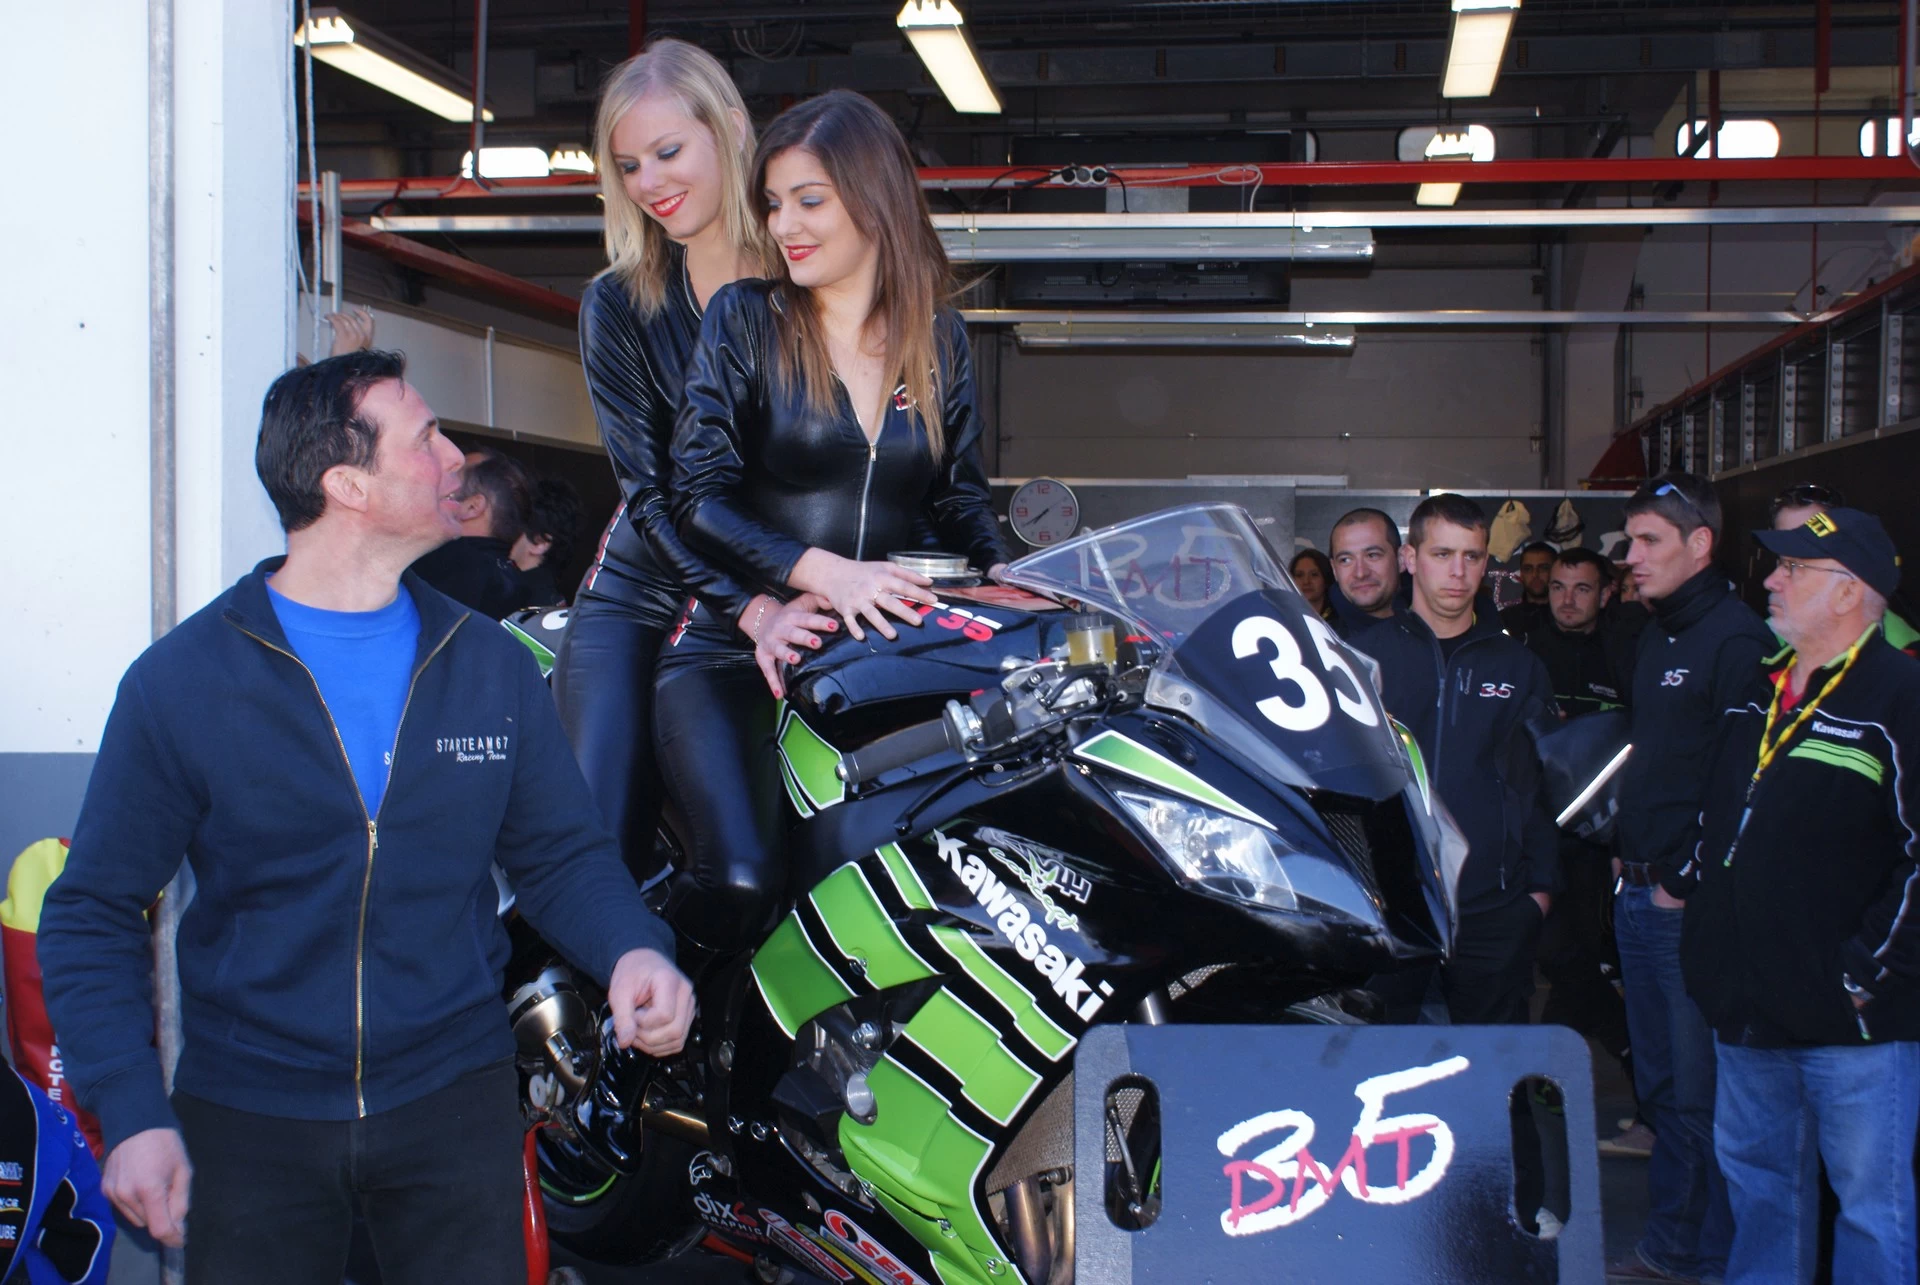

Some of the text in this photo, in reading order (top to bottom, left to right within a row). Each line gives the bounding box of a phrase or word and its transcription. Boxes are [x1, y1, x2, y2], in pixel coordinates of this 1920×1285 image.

[1037, 483, 1050, 494] 12
[1016, 507, 1028, 517] 9
[1062, 506, 1073, 517] 3
[1039, 531, 1051, 541] 6
[1232, 615, 1379, 732] 35
[1660, 669, 1690, 686] 35
[1479, 682, 1515, 698] 35
[456, 750, 507, 763] Racing Team
[934, 828, 1115, 1023] Kawasaki
[1217, 1055, 1470, 1237] 35
[701, 1213, 763, 1235] GRAPHIC
